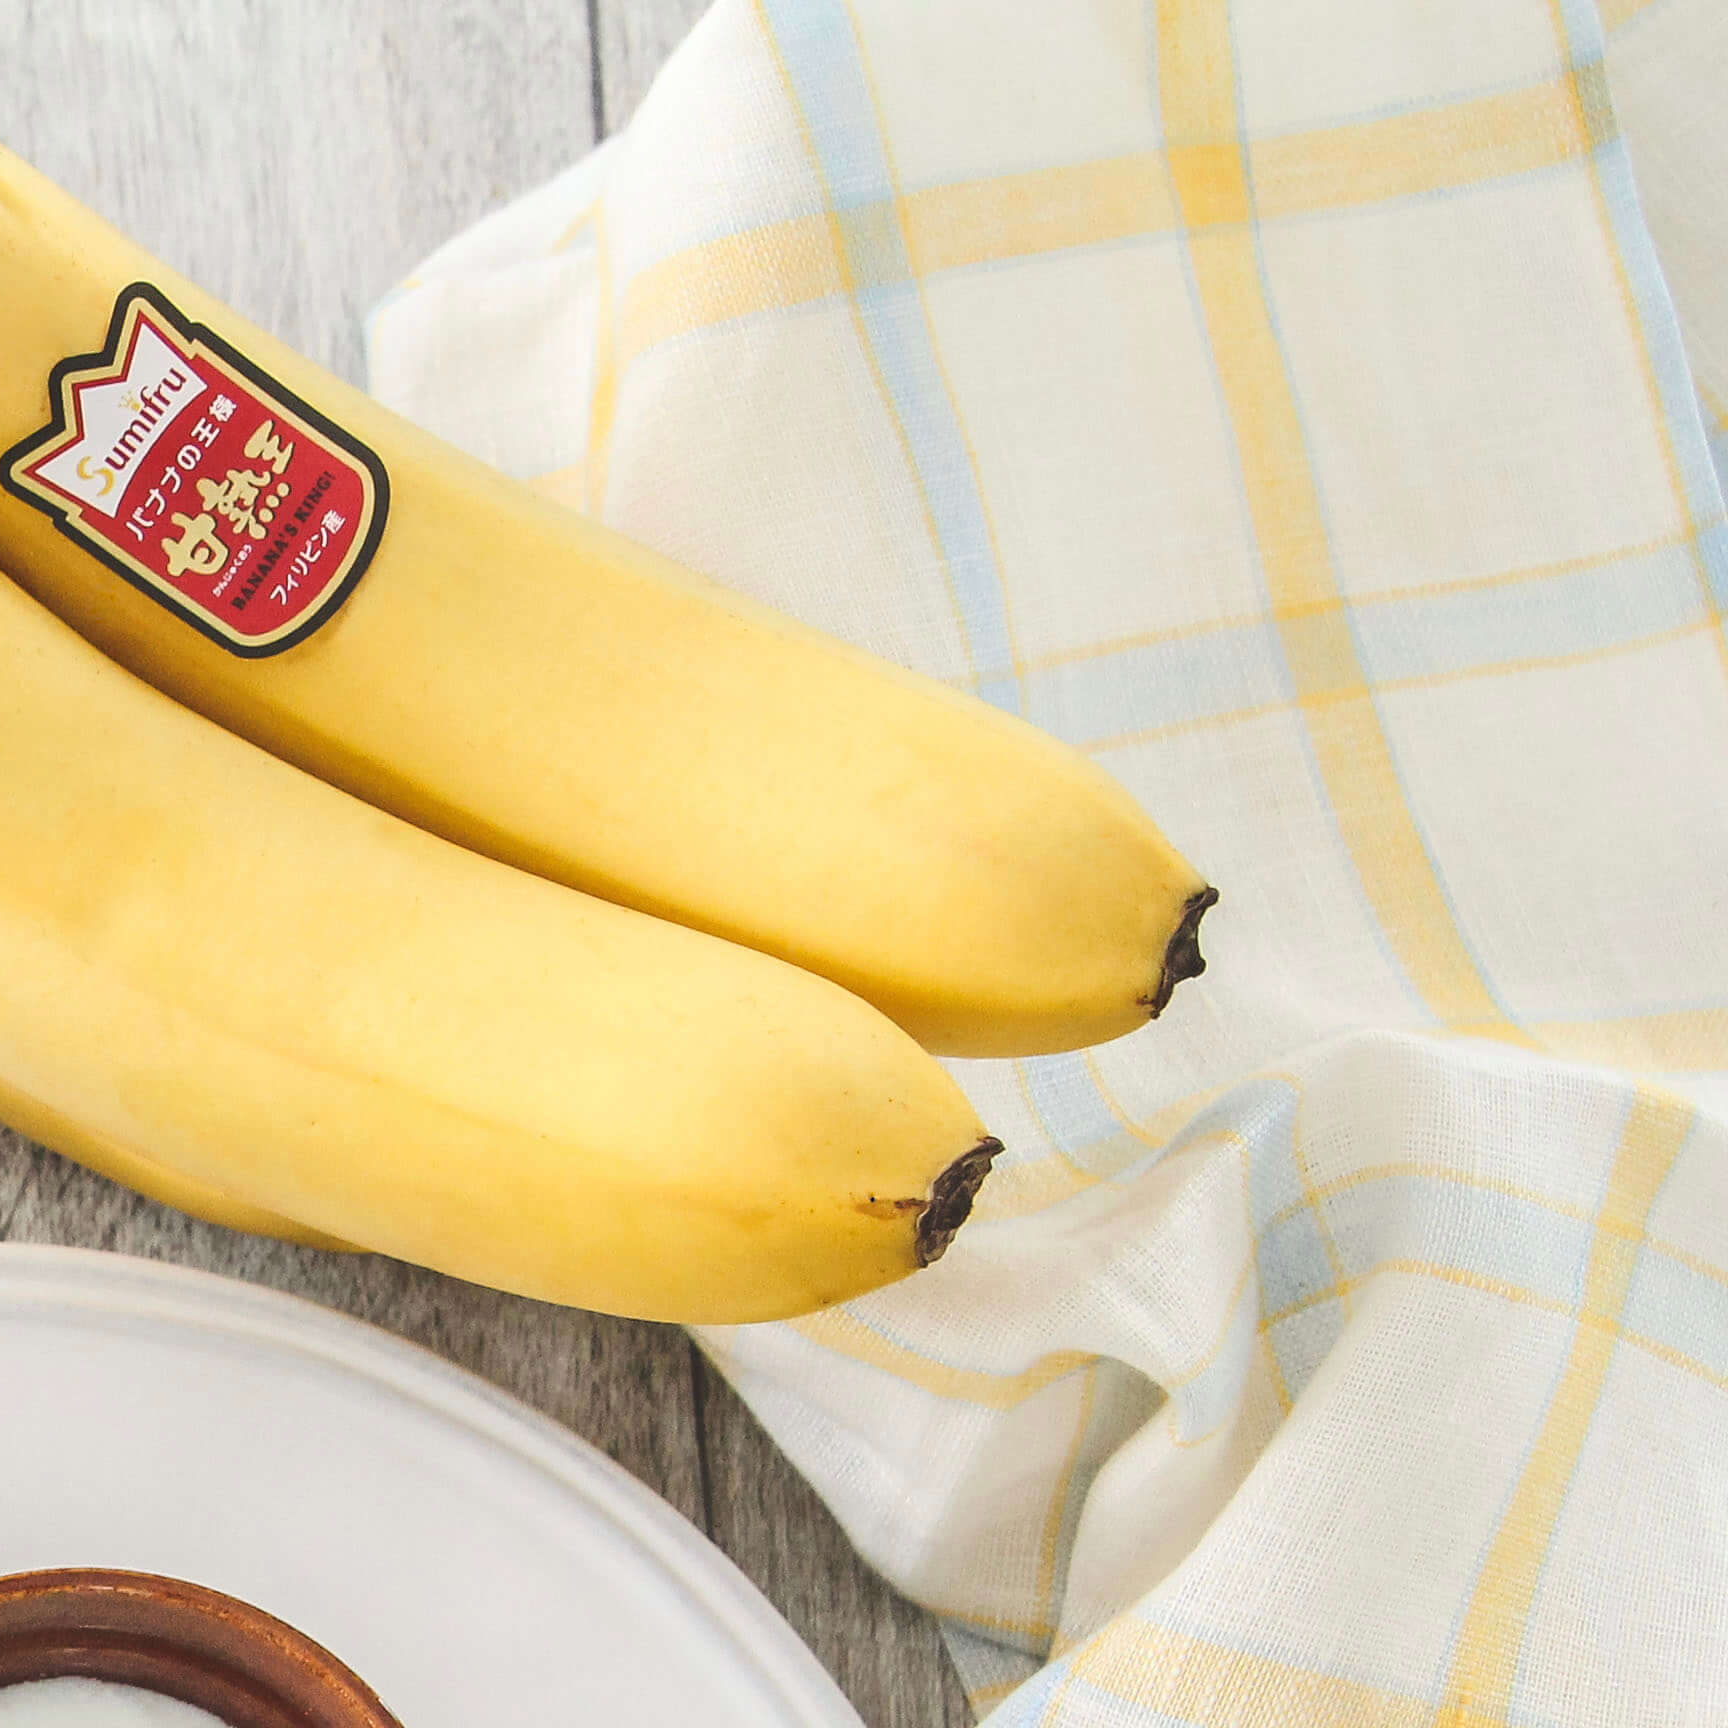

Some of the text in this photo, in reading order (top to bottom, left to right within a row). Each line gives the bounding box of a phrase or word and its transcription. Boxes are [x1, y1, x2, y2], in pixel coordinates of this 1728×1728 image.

[77, 367, 187, 497] Sumifru
[124, 394, 238, 541] バナナの王様
[161, 420, 295, 577] 甘熟王
[231, 470, 335, 611] BANANA'S KING!
[269, 510, 346, 605] フィリピン産
